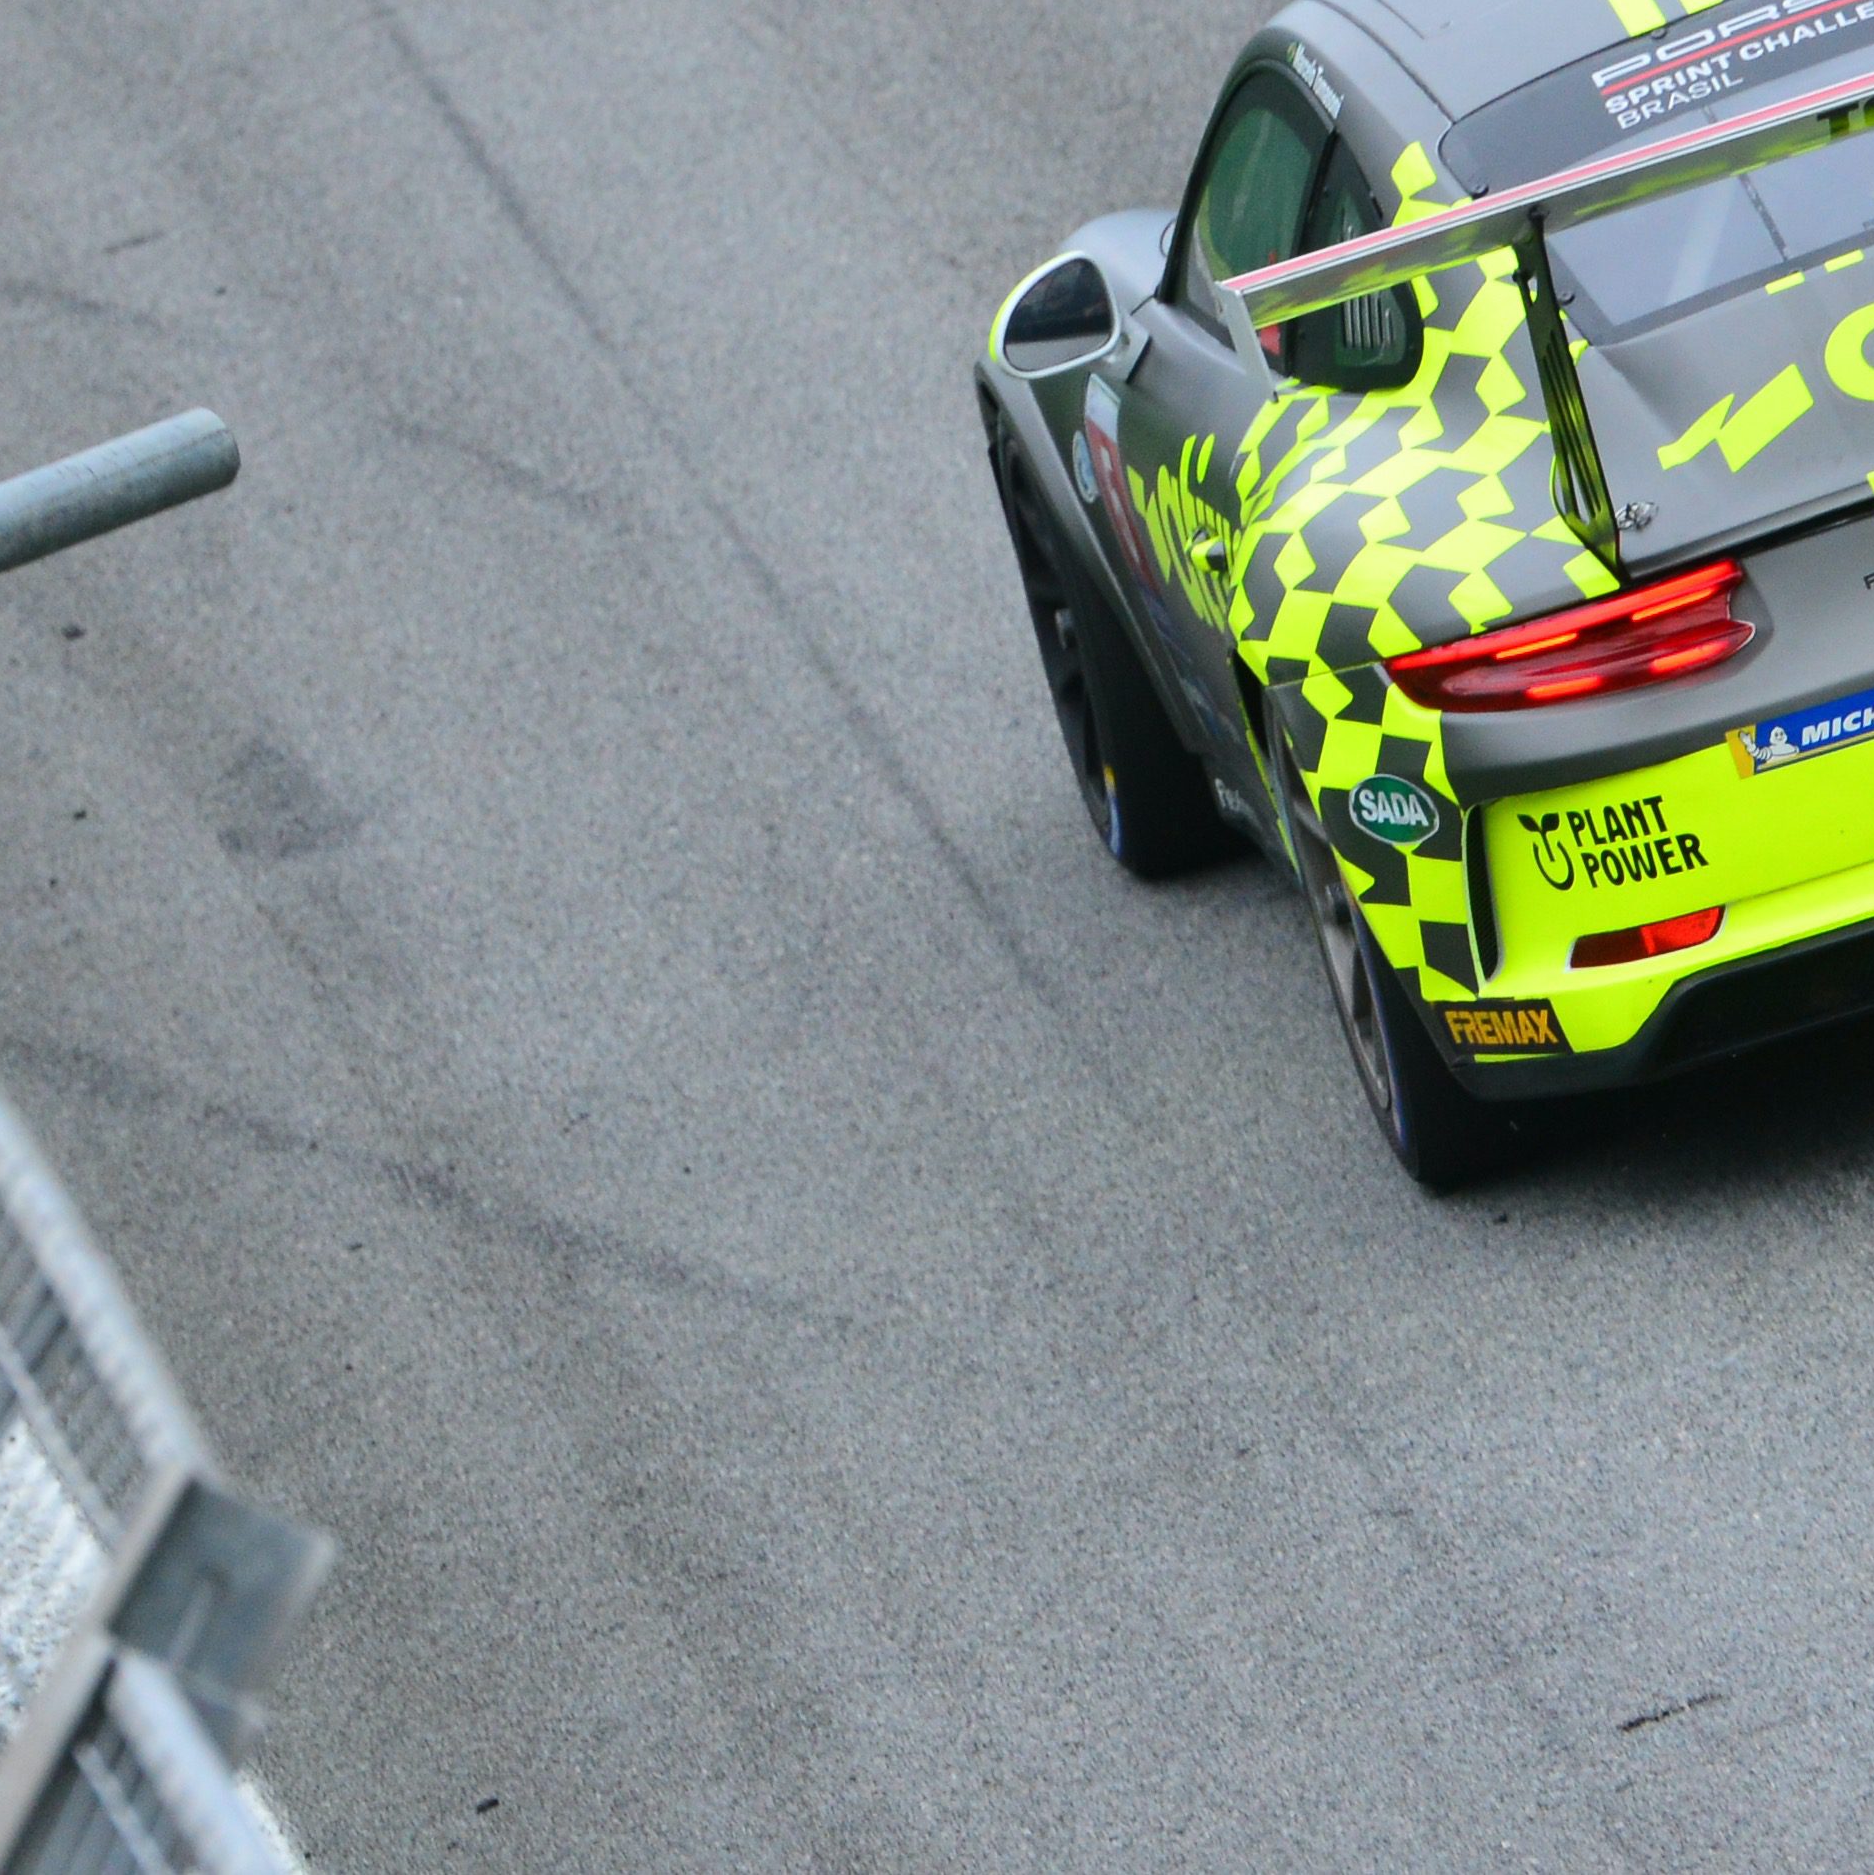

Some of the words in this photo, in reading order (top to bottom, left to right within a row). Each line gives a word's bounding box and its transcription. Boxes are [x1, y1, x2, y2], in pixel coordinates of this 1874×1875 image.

[1604, 50, 1733, 115] SPRINT
[1616, 71, 1745, 130] BRASIL
[1357, 788, 1430, 828] SADA
[1566, 795, 1669, 848] PLANT
[1581, 832, 1709, 889] POWER
[1444, 1008, 1560, 1046] FREMAX
